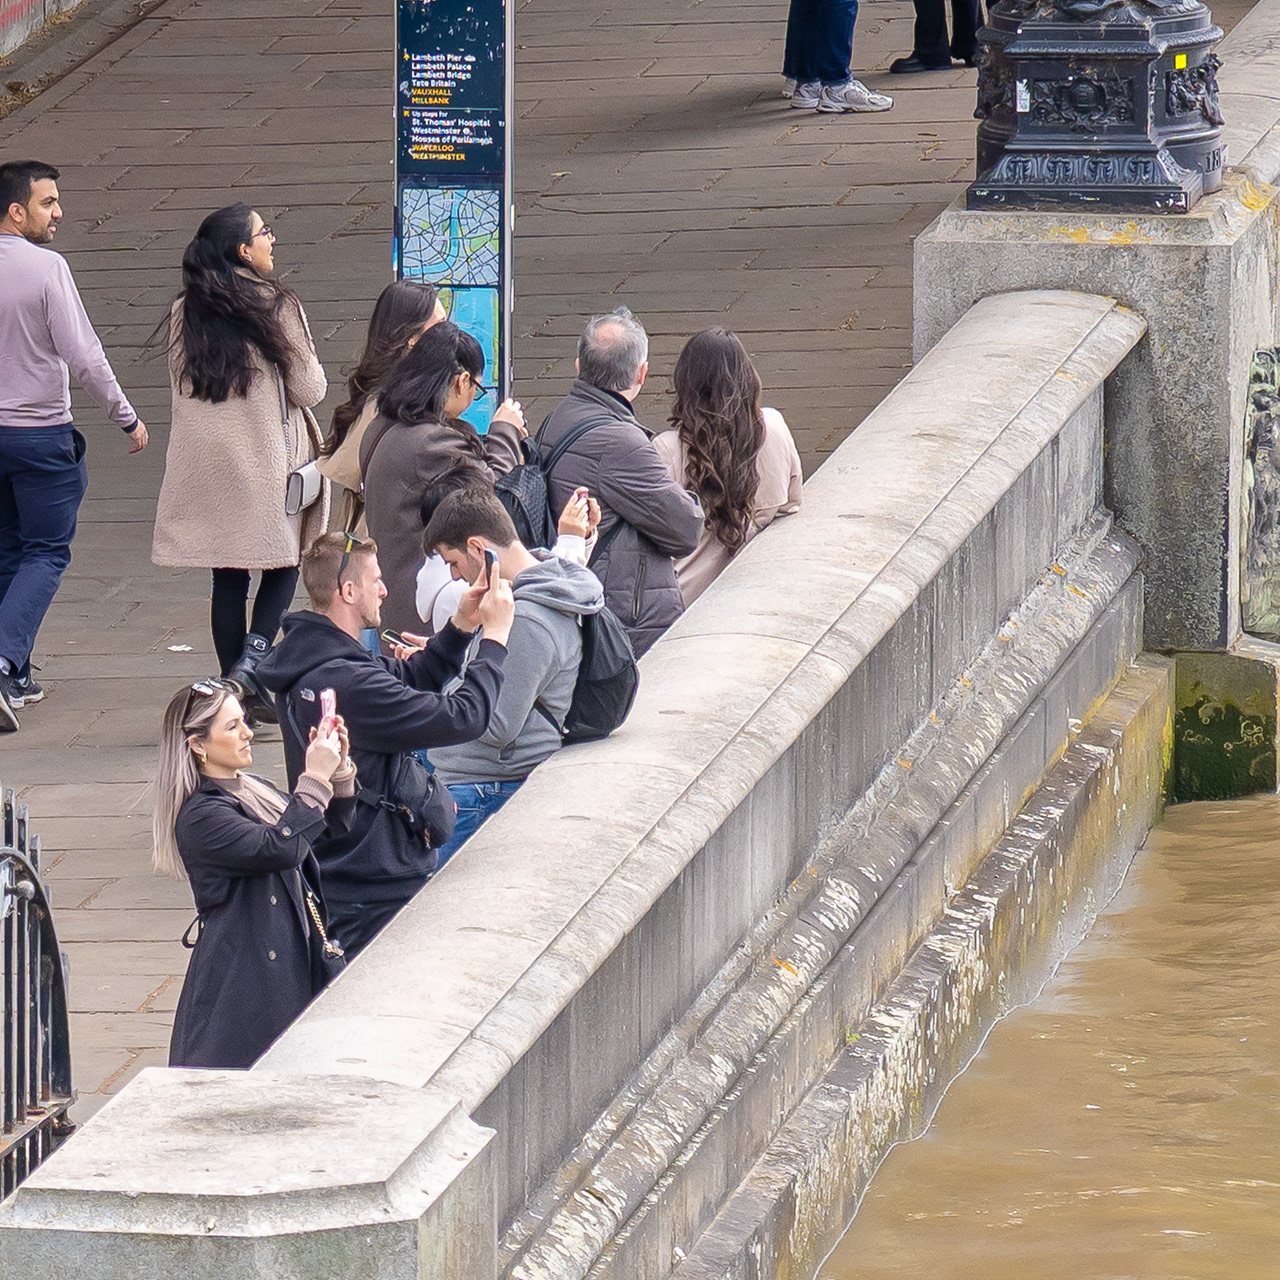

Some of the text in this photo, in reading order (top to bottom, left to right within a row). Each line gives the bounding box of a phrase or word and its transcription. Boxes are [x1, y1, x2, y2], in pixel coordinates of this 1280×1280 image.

[411, 53, 462, 62] Lambeth Pier
[411, 62, 472, 71] Lambeth Palace
[411, 70, 472, 80] Lambeth Bridge
[411, 79, 456, 88] Tate Britain
[412, 88, 452, 96] VAUXHALL
[411, 97, 450, 105] MILLBANK
[412, 118, 423, 126] St.
[458, 118, 491, 127] Hospital
[411, 127, 461, 135] Westminster
[411, 135, 493, 144] Houses of Parliament
[411, 144, 454, 152] WATERLOO
[411, 153, 466, 161] WESTMINSTER
